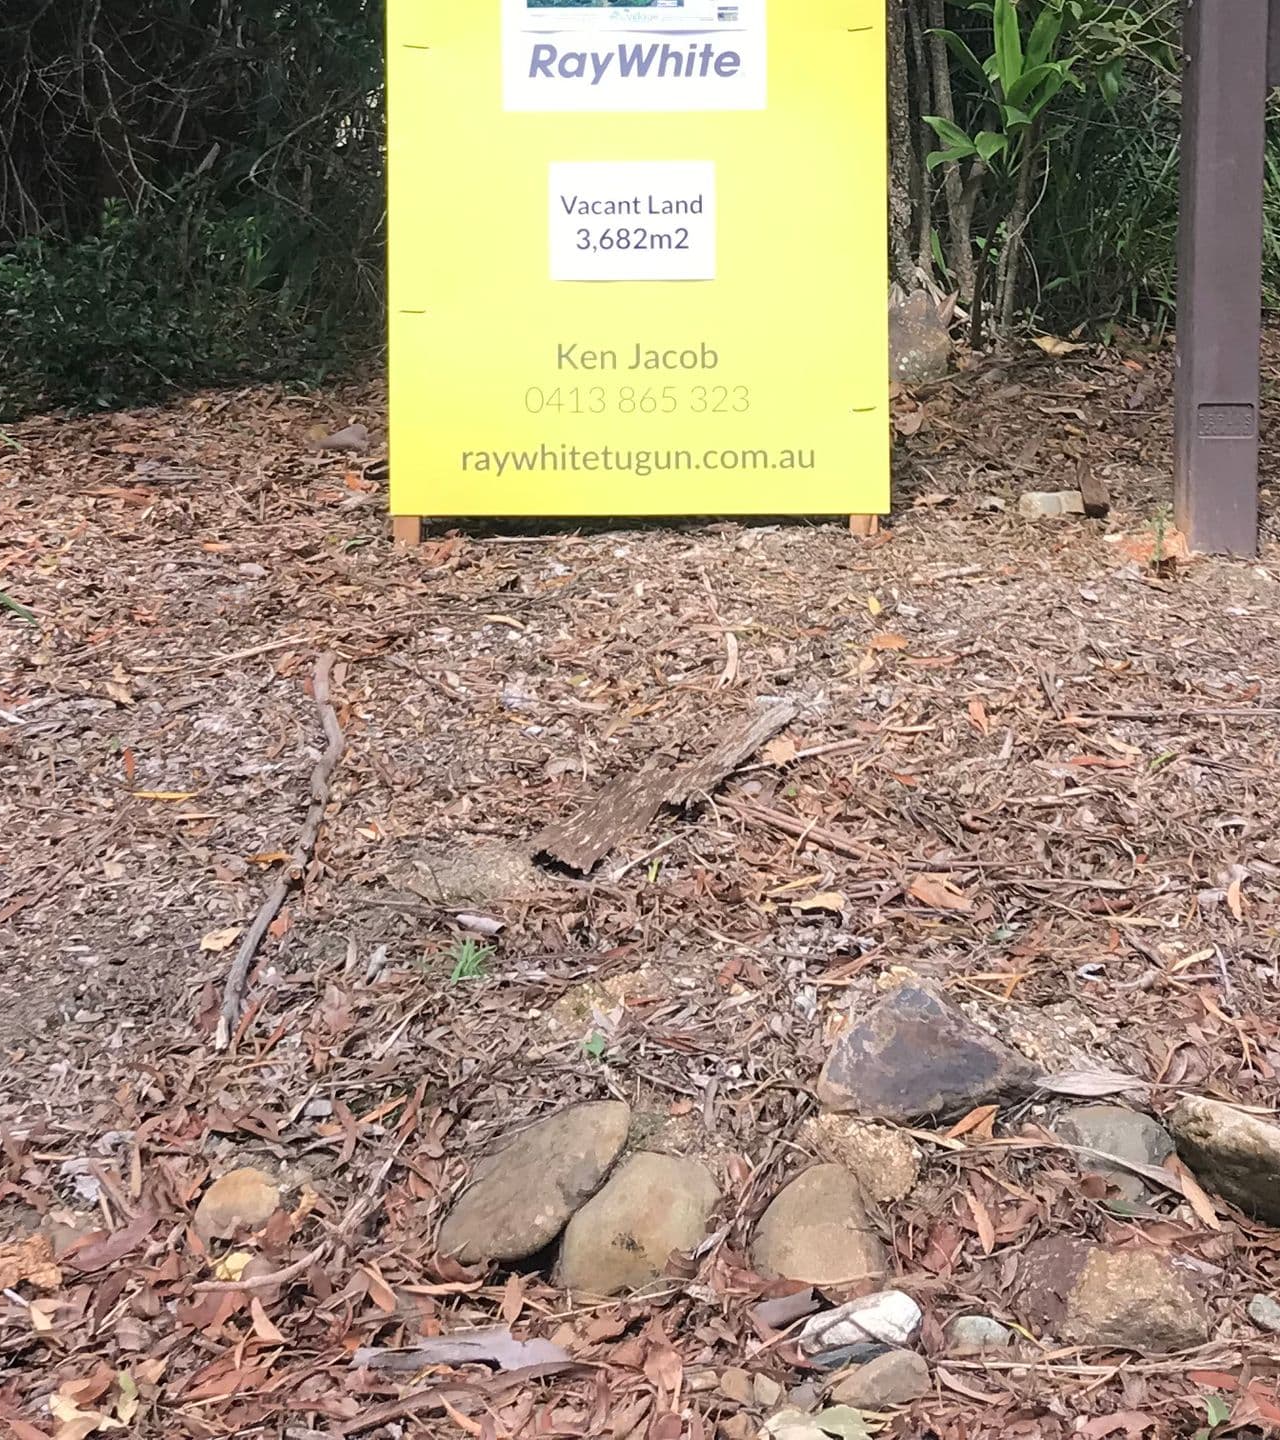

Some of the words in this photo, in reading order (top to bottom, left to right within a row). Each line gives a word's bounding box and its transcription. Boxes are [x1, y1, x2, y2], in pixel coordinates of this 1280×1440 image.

[560, 195, 641, 216] Vacant
[647, 194, 703, 215] Land
[575, 227, 690, 254] 3,682m2
[556, 343, 617, 370] Ken
[627, 342, 718, 370] Jacob
[524, 385, 607, 414] 0413
[617, 385, 678, 414] 865
[689, 385, 751, 413] 323
[461, 443, 815, 477] raywhitetugun.com.au
